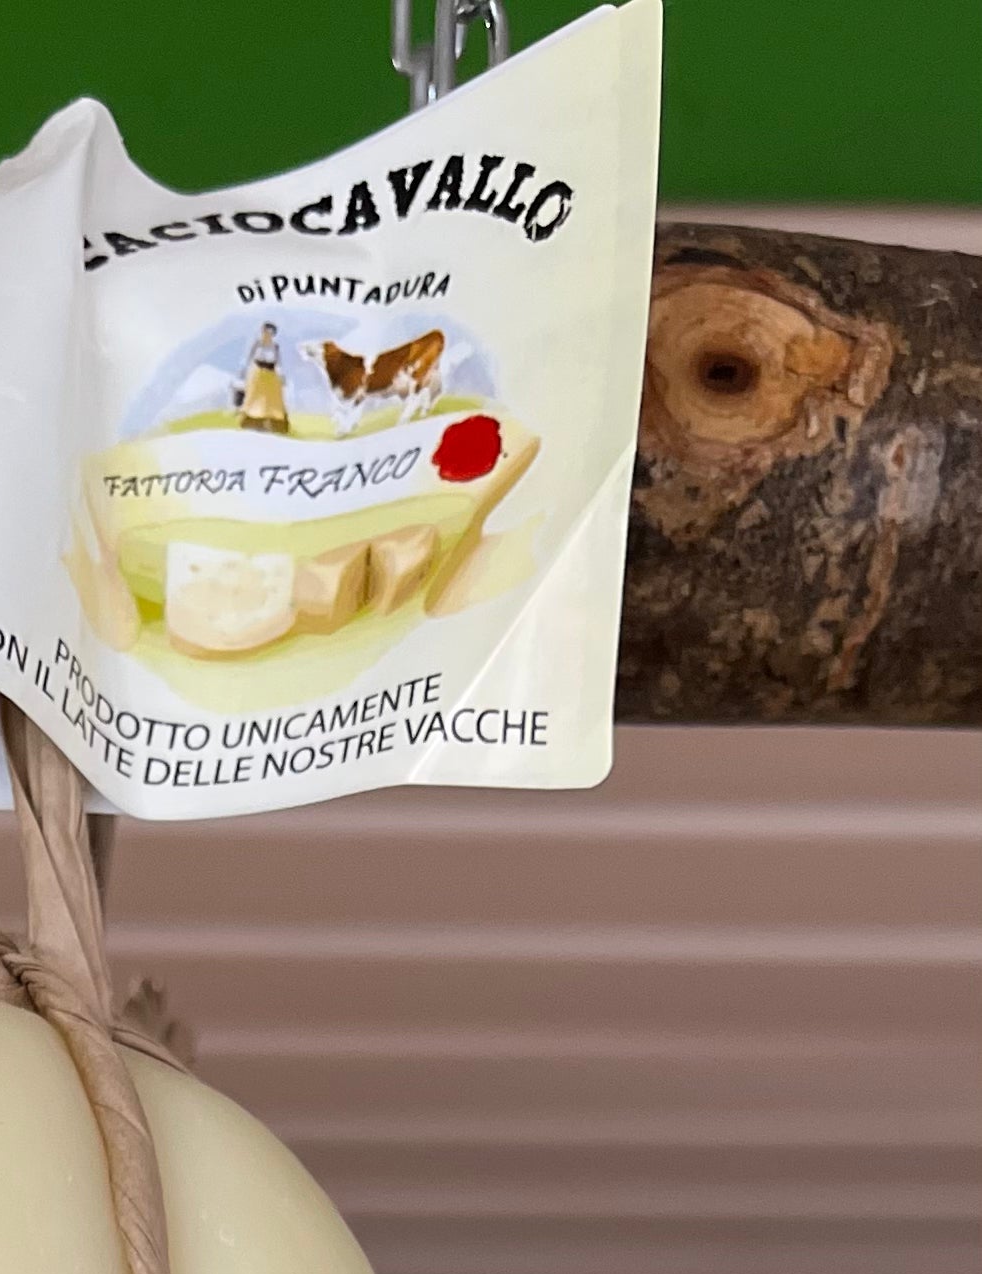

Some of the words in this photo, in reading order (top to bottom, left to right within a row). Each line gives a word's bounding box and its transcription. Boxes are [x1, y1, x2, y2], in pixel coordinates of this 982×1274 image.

[103, 470, 246, 498] FATTORIA
[258, 448, 422, 498] FRANCO
[33, 658, 55, 702] IL
[61, 693, 133, 778] LATTE
[143, 755, 252, 787] DELLE
[261, 728, 395, 780] NOSTRE
[404, 708, 550, 746] VACCHE
[53, 637, 210, 751] PRODOTTO
[221, 672, 443, 749] UNICAMENTE
